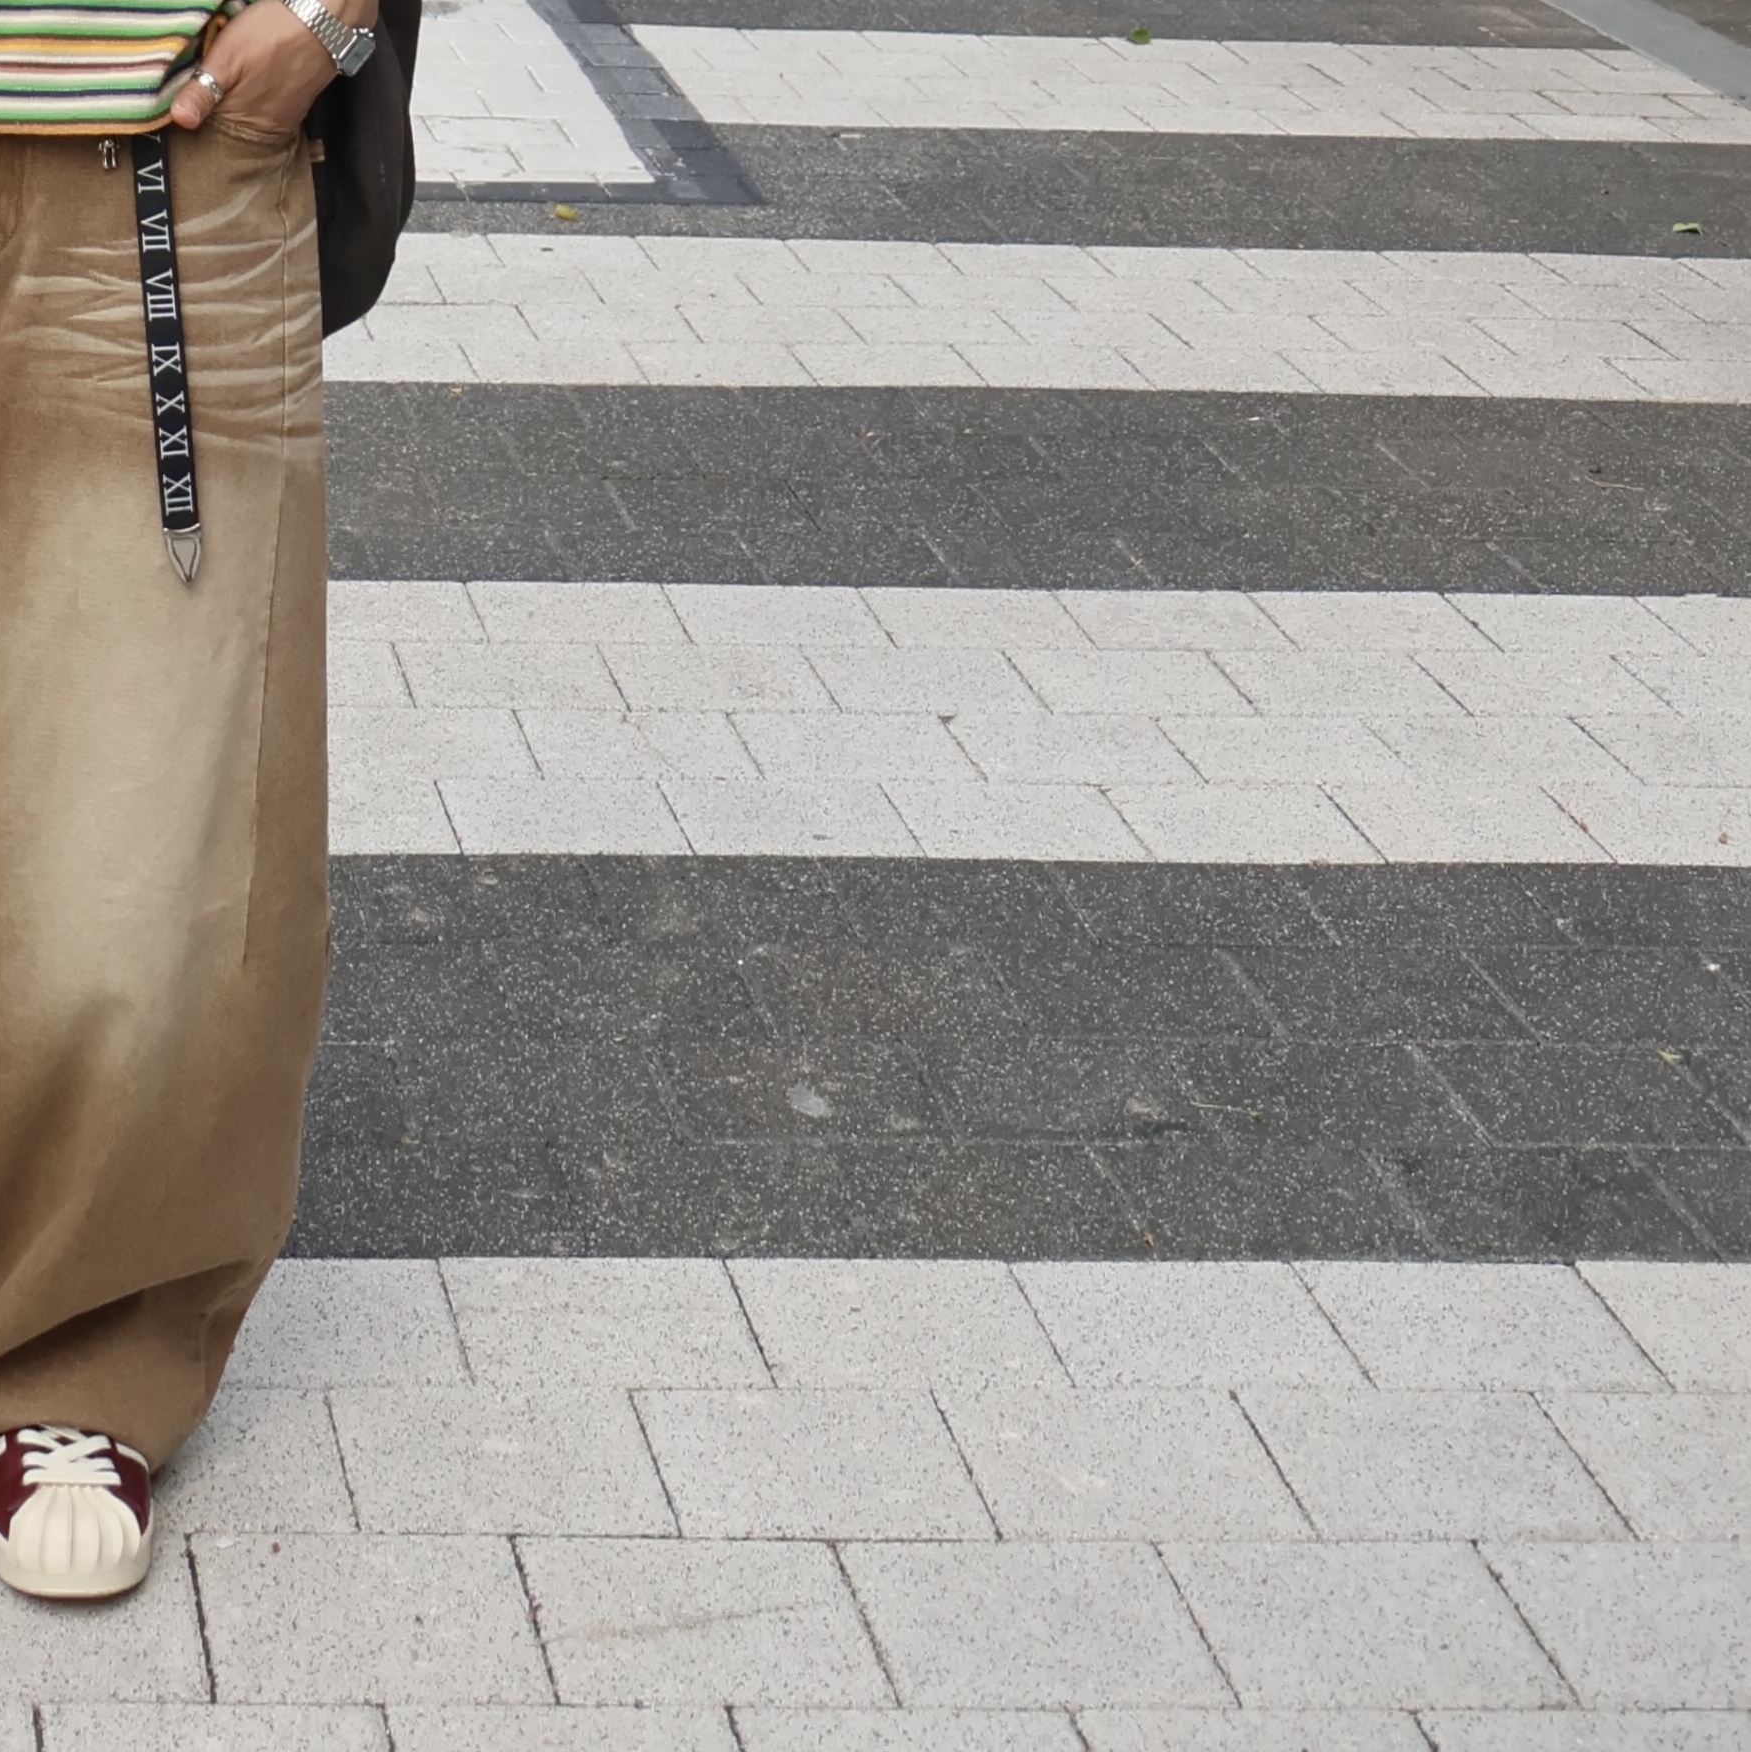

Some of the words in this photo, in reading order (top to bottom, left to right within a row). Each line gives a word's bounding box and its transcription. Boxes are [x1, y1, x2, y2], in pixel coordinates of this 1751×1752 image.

[136, 158, 166, 194] VI
[140, 208, 171, 253] VII
[145, 267, 178, 322] VIII
[151, 341, 182, 377] IX
[155, 390, 186, 416] X
[159, 424, 189, 461] XI
[163, 471, 194, 517] XII
